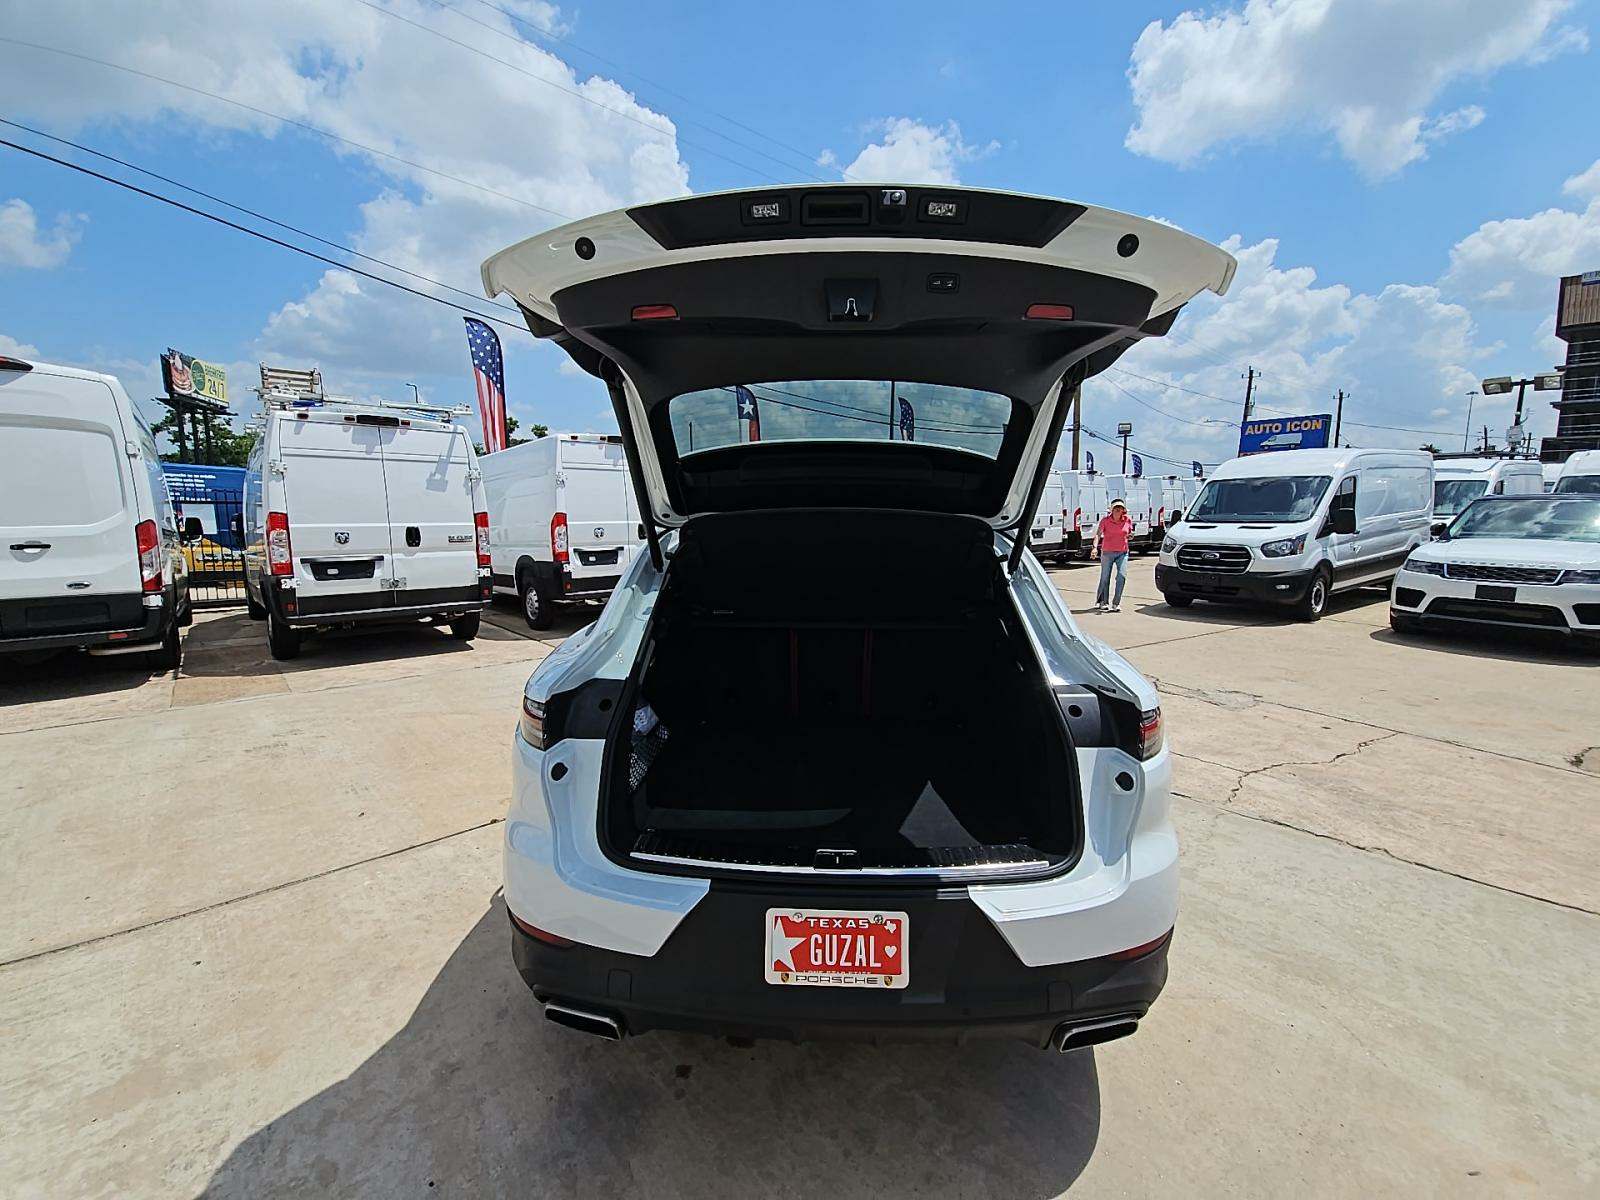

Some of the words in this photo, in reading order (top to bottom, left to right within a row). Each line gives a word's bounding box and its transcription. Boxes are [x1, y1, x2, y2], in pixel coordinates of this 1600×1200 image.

[1245, 423, 1282, 435] AUTO
[1286, 419, 1322, 432] ICON
[807, 918, 869, 929] TEXAS
[810, 933, 882, 967] GUZAL
[795, 975, 879, 984] PORSCHE
